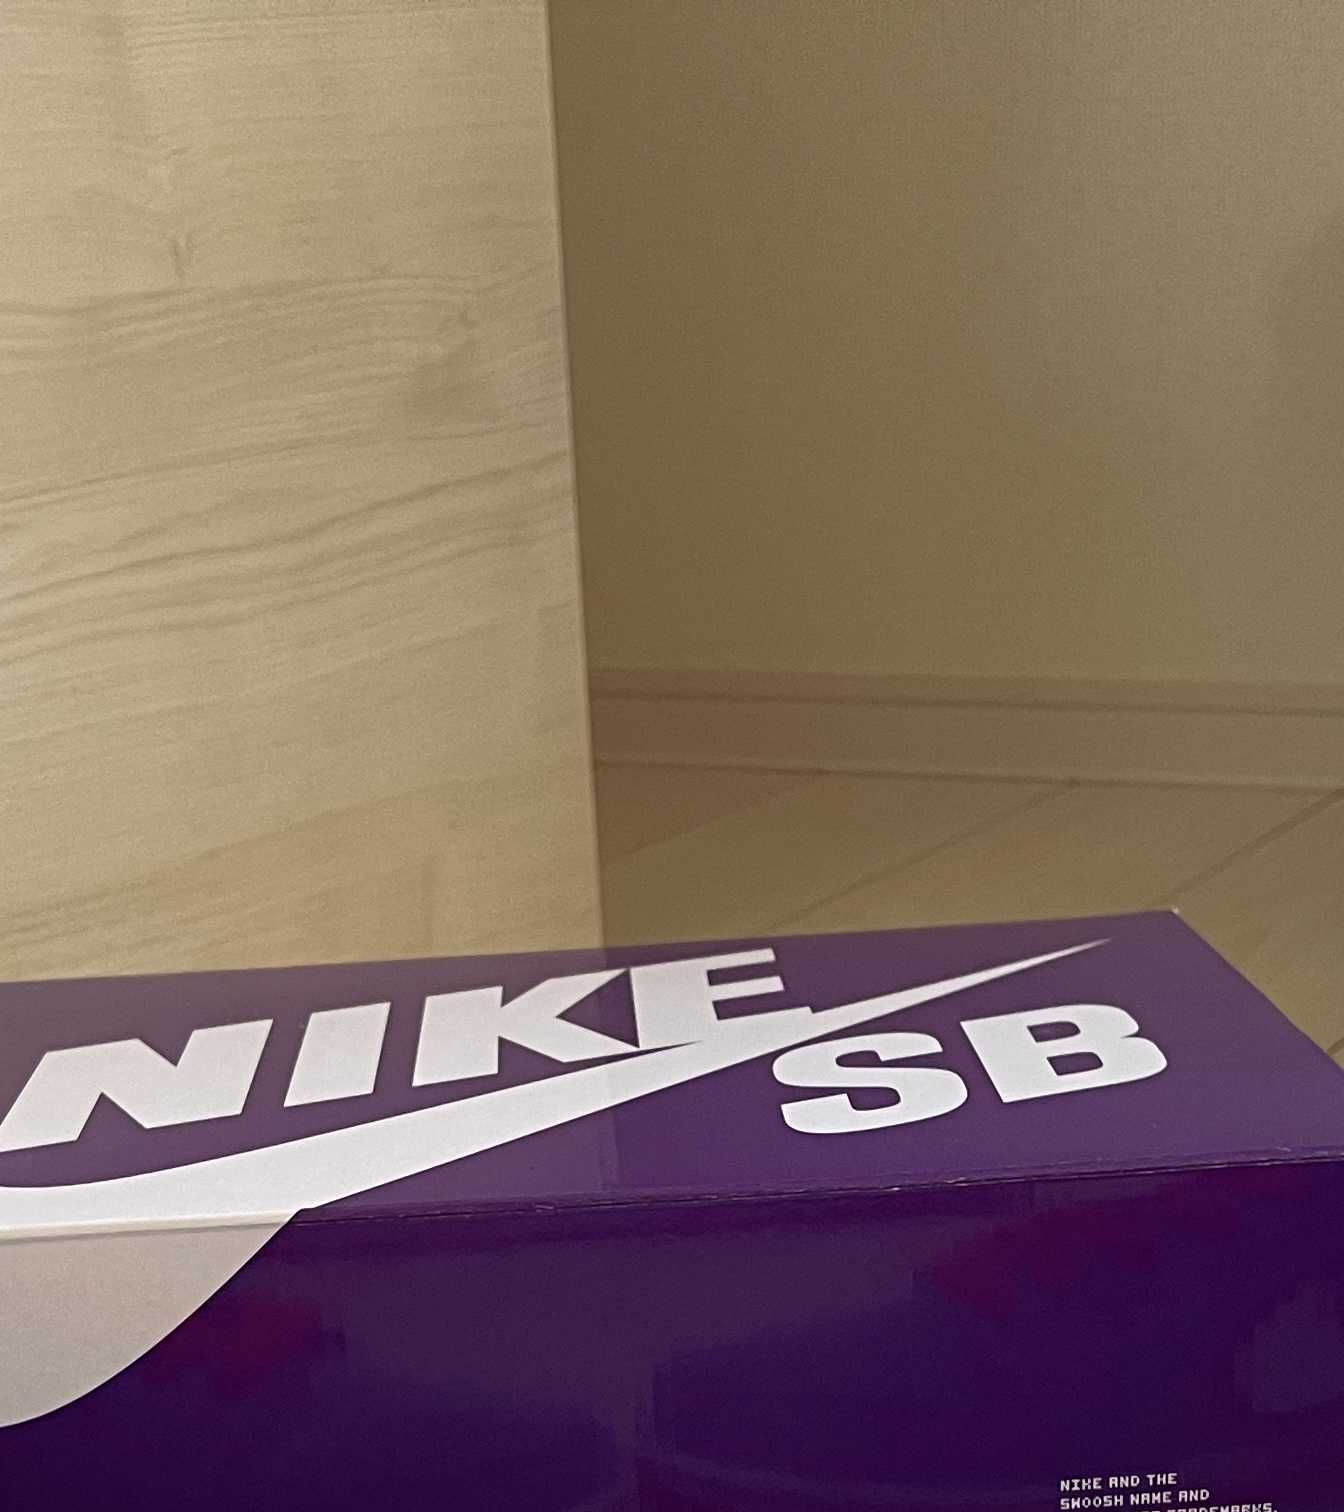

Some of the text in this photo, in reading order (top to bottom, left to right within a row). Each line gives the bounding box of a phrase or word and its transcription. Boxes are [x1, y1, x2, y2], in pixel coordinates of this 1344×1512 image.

[771, 1003, 1170, 1134] SB
[1060, 1472, 1178, 1491] NIKE AND THE
[1060, 1488, 1210, 1510] SWOOSH NAME AND
